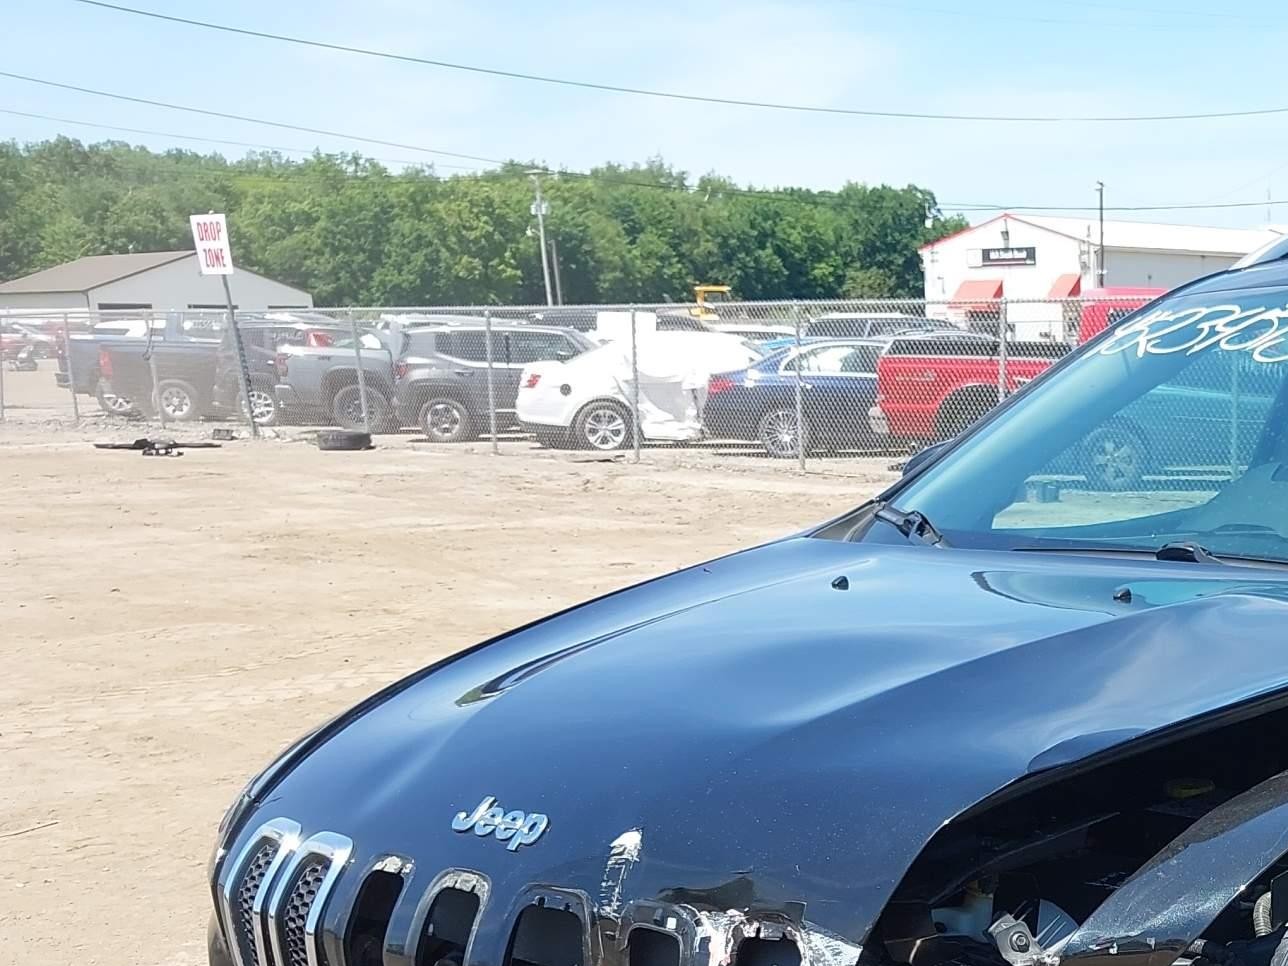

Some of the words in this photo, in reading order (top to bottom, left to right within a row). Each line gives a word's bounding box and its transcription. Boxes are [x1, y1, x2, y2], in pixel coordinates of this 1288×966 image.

[196, 221, 221, 241] DROP
[202, 248, 226, 268] ZONE
[451, 795, 549, 852] Jeep
